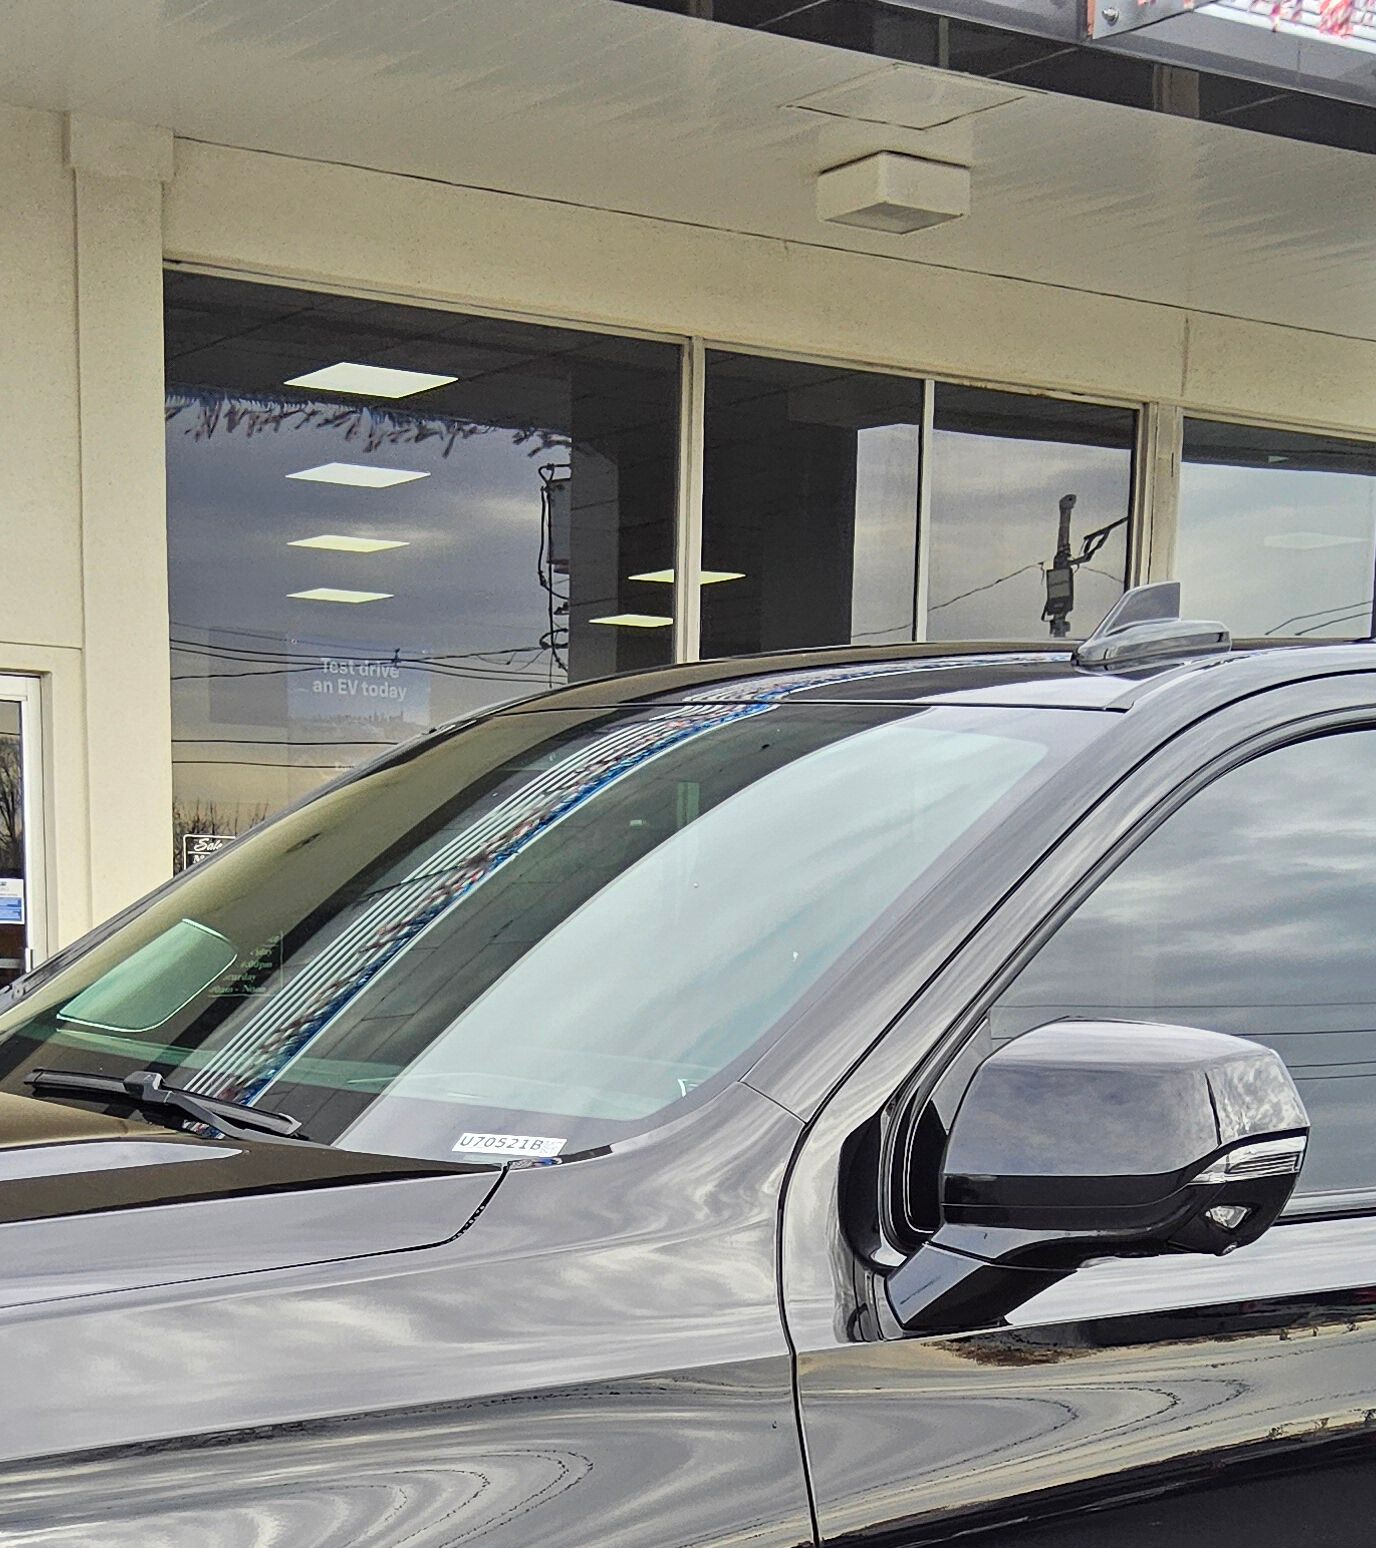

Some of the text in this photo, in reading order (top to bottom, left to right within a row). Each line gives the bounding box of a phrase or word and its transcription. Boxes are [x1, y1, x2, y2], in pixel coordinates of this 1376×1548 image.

[321, 658, 400, 679] Test drive
[312, 679, 407, 701] an EV today
[459, 1135, 544, 1151] U70521B
